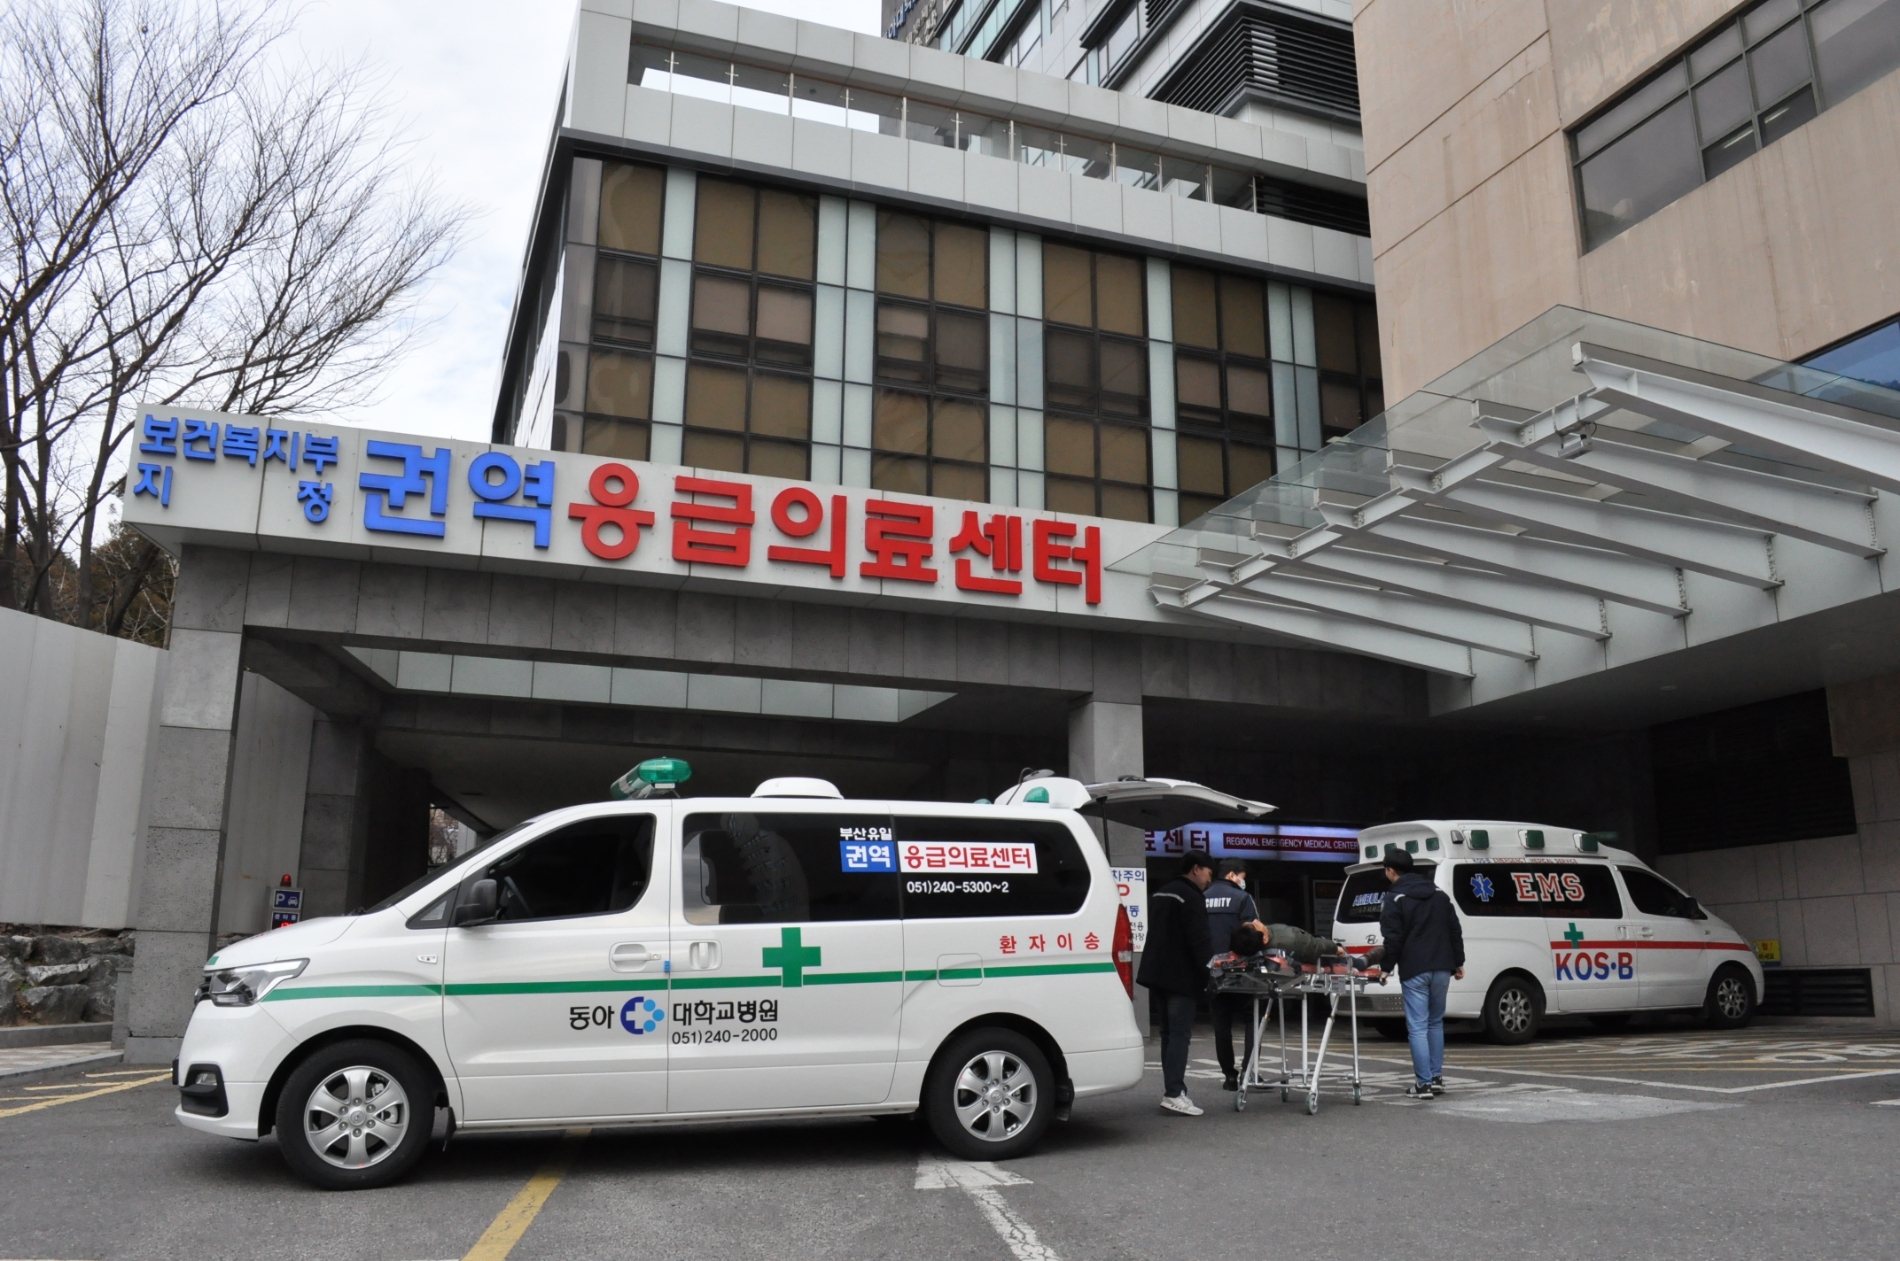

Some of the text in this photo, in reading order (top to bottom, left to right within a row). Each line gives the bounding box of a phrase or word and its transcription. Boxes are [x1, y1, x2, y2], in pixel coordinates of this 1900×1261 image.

[139, 413, 339, 475] 보건복지부
[359, 439, 1102, 605] 권역 응급의료센터
[839, 827, 893, 841] 부산유일
[1225, 837, 1359, 850] REGIONAL EMERGENCY MEDICAL CENTER
[845, 845, 1032, 869] 권역 응급의료센터
[906, 880, 1010, 895] 051)240-5300~2
[1510, 872, 1585, 902] EMS
[275, 893, 285, 905] P
[999, 932, 1101, 955] 환자이송
[569, 999, 779, 1031] 동아 대학교병원
[671, 1027, 778, 1046] 051)240-2000
